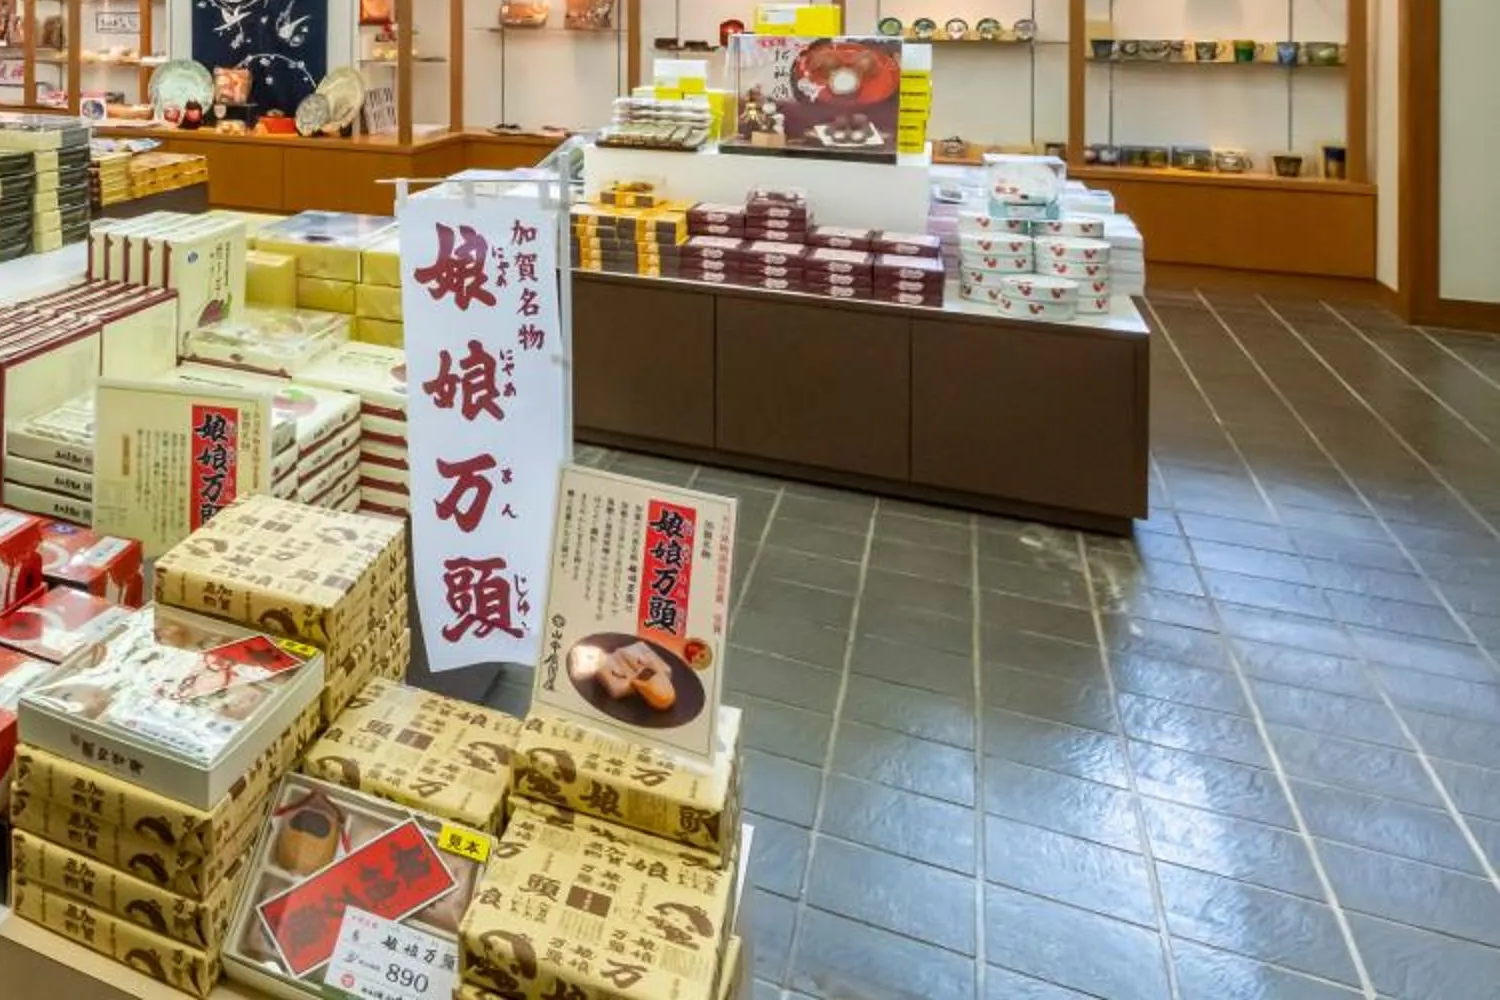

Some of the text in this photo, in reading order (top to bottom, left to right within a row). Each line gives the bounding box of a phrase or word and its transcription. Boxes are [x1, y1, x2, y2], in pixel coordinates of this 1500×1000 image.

[510, 218, 546, 351] 加賀名物
[413, 221, 525, 643] 娘娘万頭
[644, 508, 686, 636] 娘娘万頭
[385, 963, 430, 993] 890
[600, 958, 648, 989] 万
